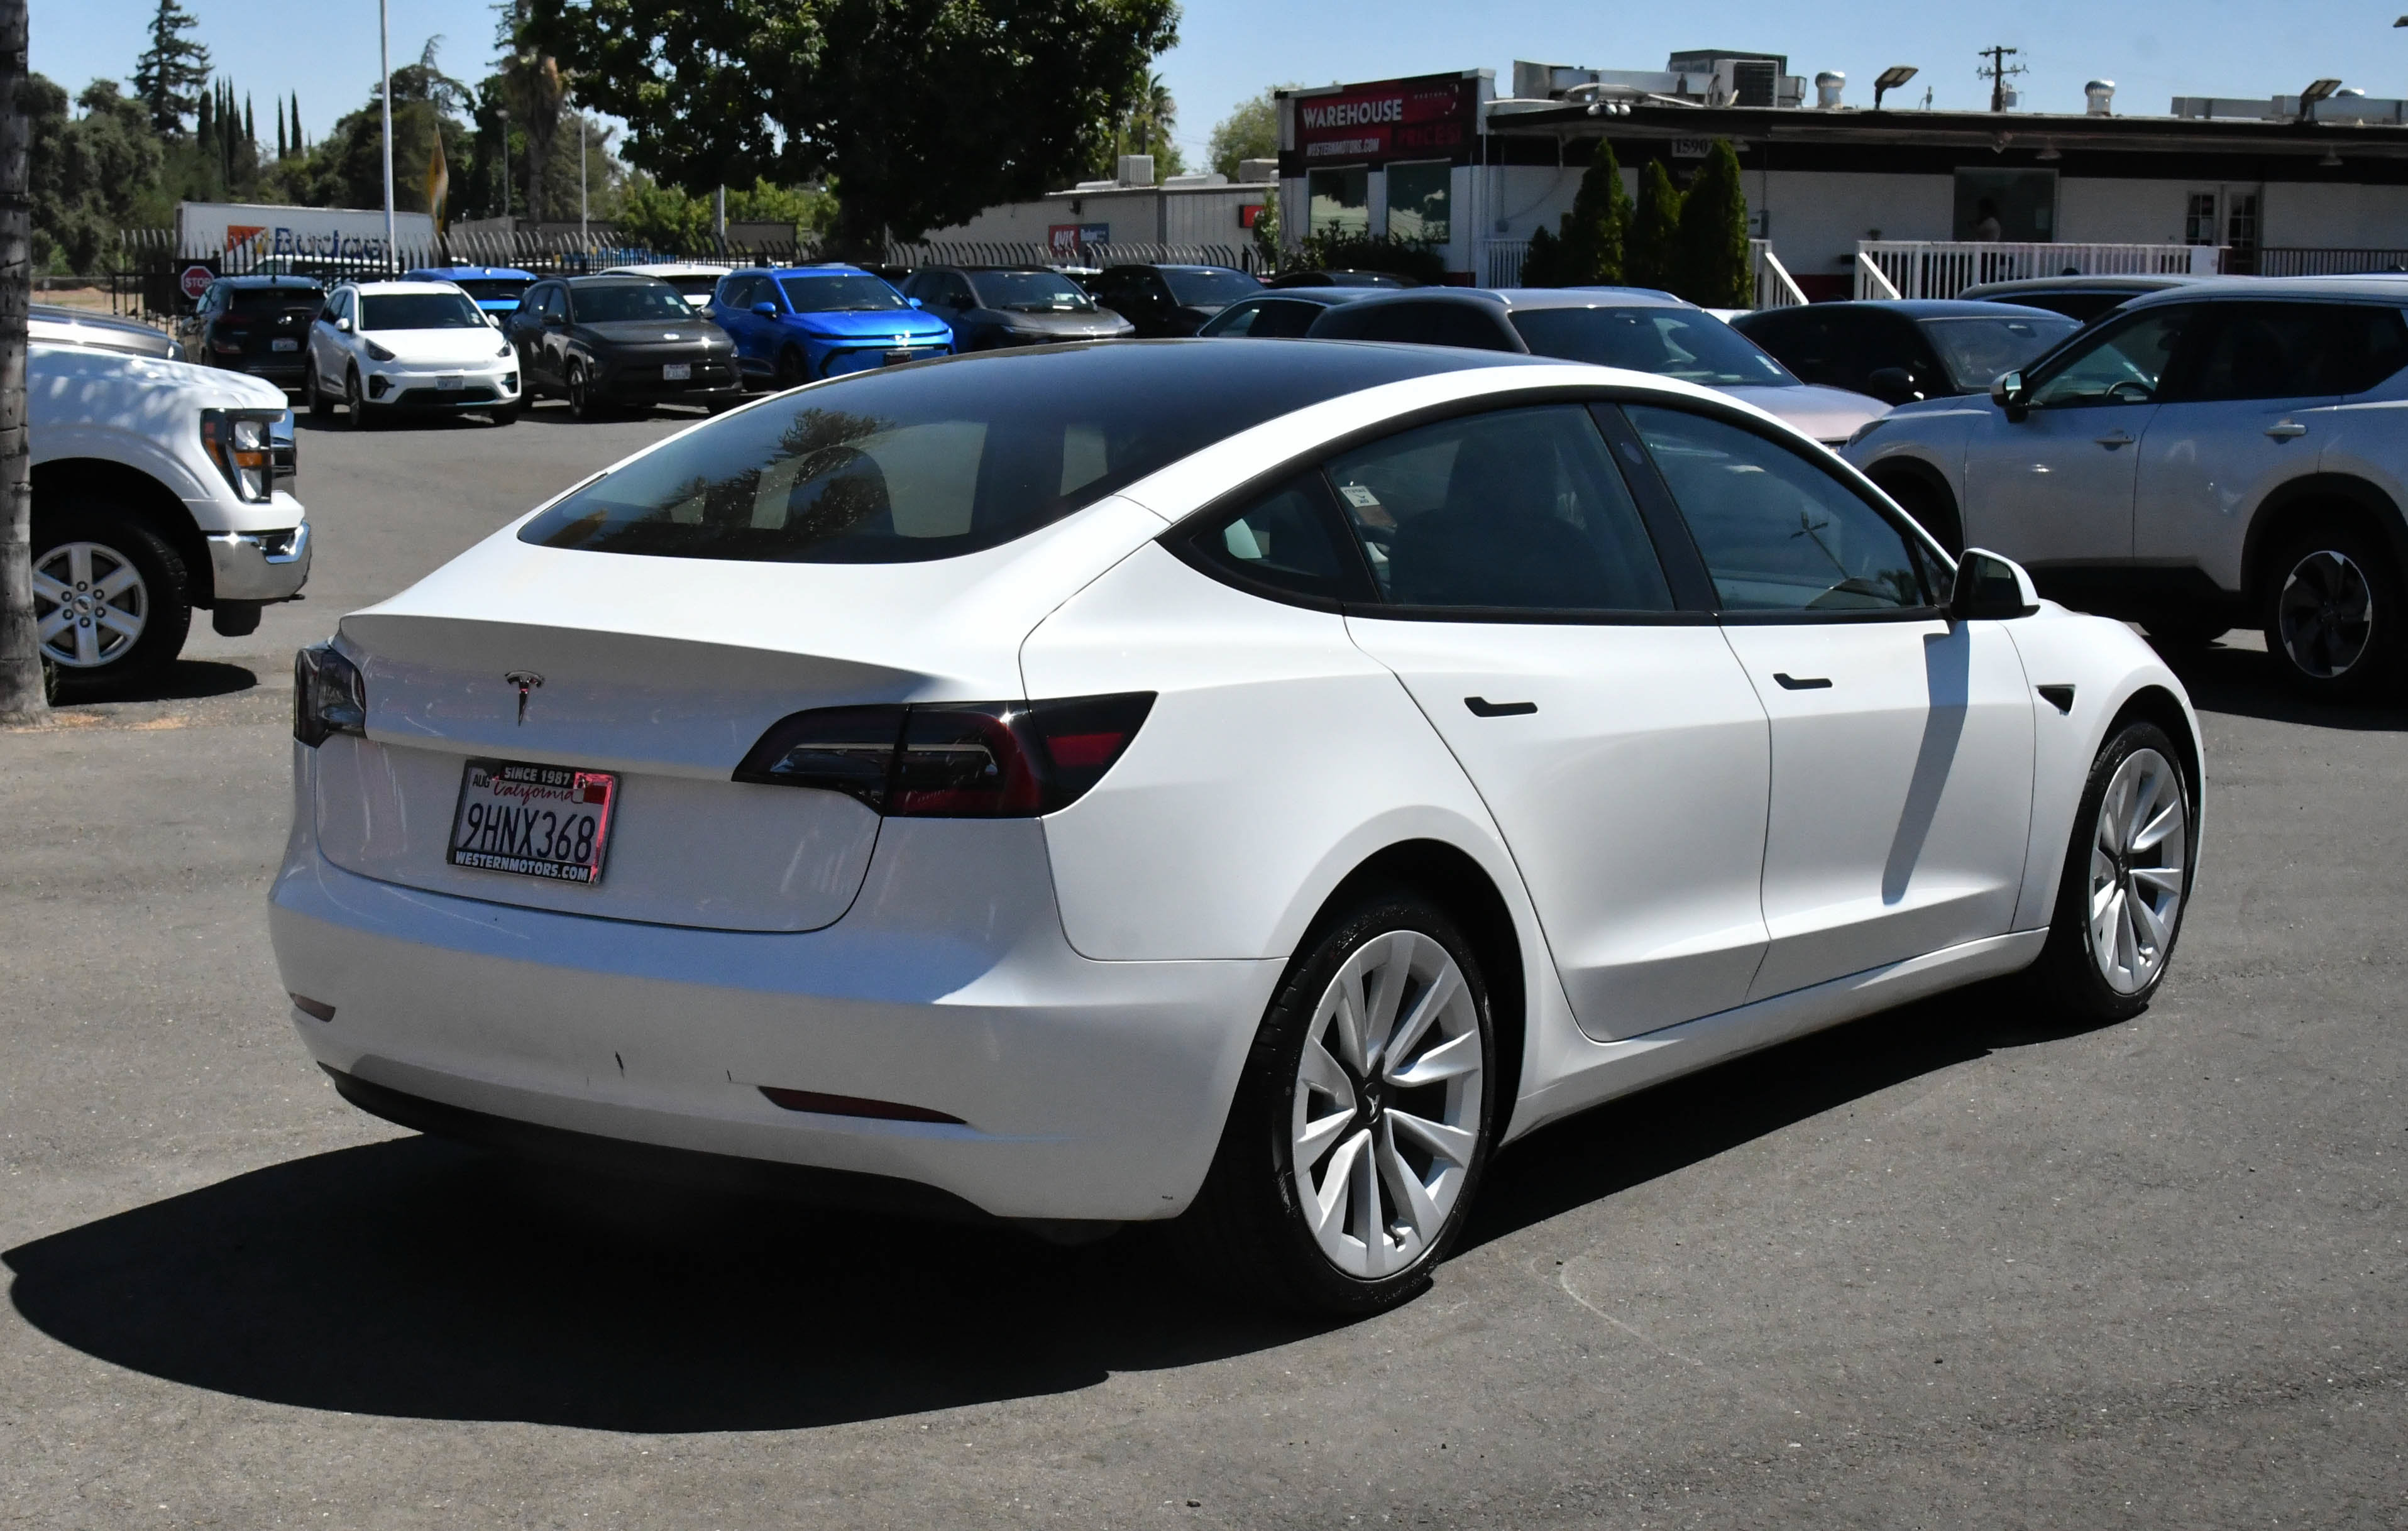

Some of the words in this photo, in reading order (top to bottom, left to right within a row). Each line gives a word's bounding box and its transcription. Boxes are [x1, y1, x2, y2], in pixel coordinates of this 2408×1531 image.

[1302, 99, 1403, 129] WAREHOUSE
[275, 228, 390, 258] Budge
[185, 277, 211, 288] STOP
[472, 774, 490, 788] AUG
[504, 767, 537, 781] SINCE
[541, 769, 571, 785] 1987
[493, 779, 583, 806] California
[462, 803, 596, 864] 9HNX368
[455, 851, 590, 882] WESTERNMOTORS.COM
